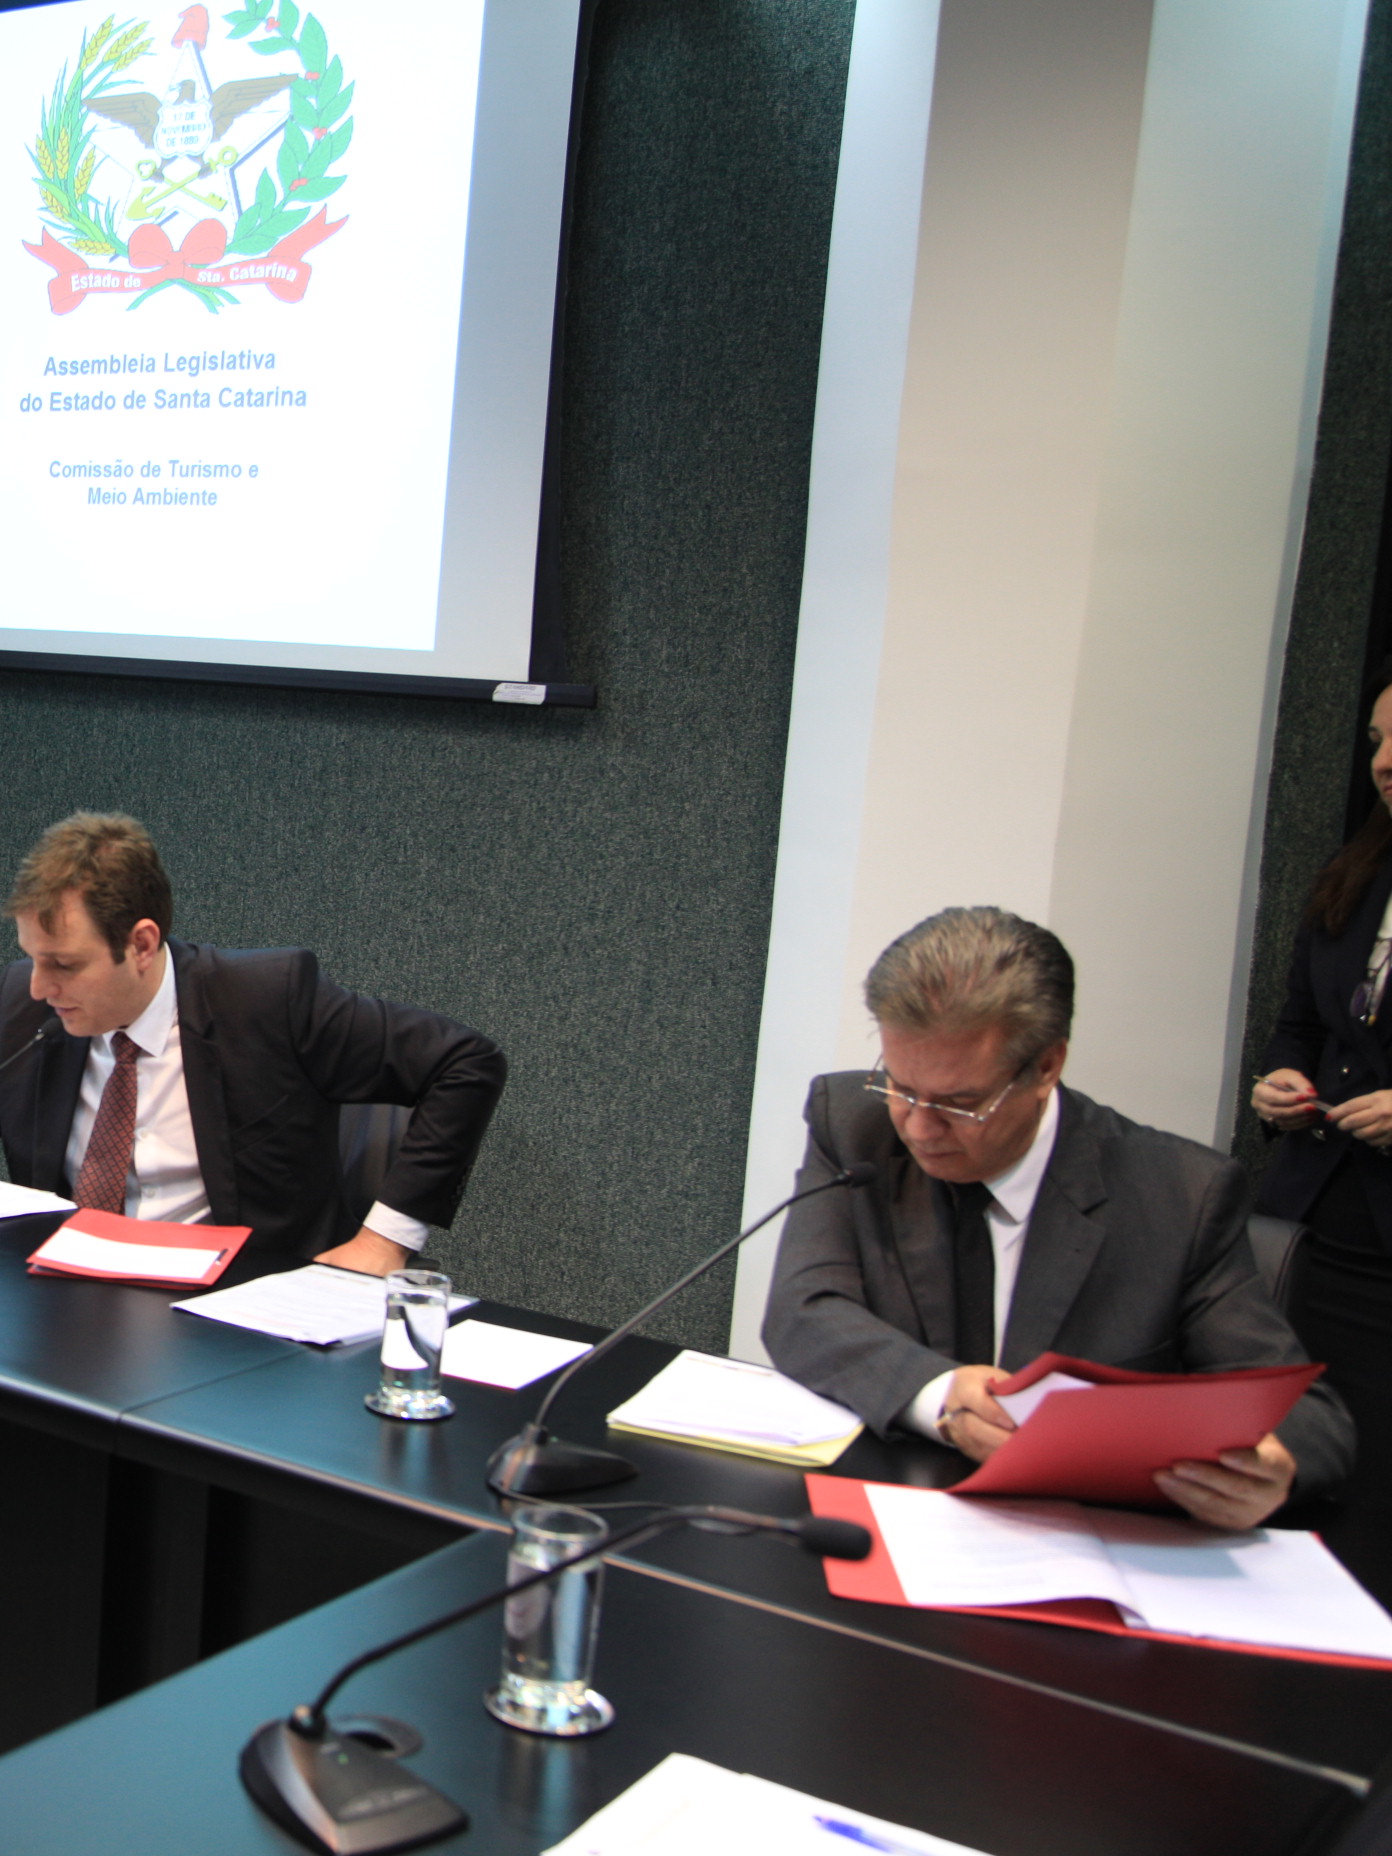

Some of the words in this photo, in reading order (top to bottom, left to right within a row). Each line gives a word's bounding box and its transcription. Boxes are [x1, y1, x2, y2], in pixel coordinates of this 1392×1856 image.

[71, 273, 120, 292] Estado
[124, 274, 141, 289] de
[197, 270, 225, 283] Sta.
[229, 262, 298, 282] Catarina
[43, 353, 156, 376] Assembleia
[164, 349, 276, 377] Legislativa
[19, 392, 43, 412] do
[49, 390, 116, 412] Estado
[123, 389, 147, 410] de
[154, 388, 211, 409] Santa
[218, 386, 307, 408] Catarina
[49, 459, 134, 478] Comissão
[140, 460, 162, 478] de
[168, 459, 242, 478] Turismo
[248, 463, 259, 478] e
[87, 487, 127, 505] Meio
[132, 487, 218, 506] Ambiente
